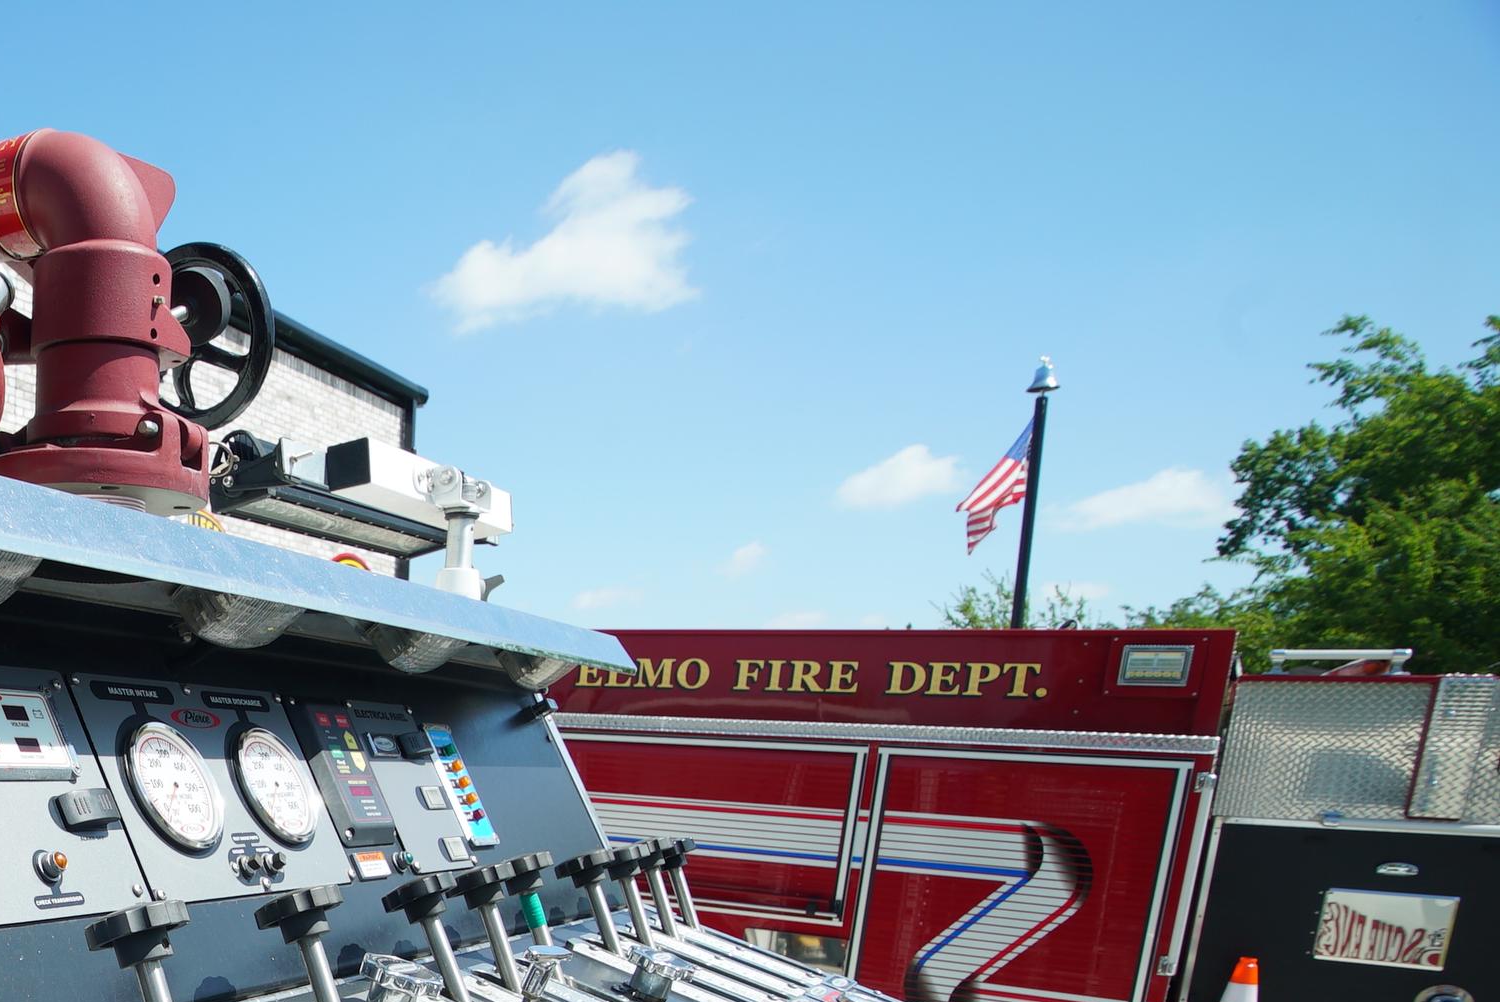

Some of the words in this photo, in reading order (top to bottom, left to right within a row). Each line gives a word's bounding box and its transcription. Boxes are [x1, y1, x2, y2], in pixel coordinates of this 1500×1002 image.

[732, 659, 859, 693] FIRE
[885, 661, 1048, 698] DEPT.
[107, 686, 134, 696] MASTER
[135, 689, 159, 699] INTAKE
[209, 695, 232, 705] MASTER
[232, 698, 262, 708] DISCHARGE
